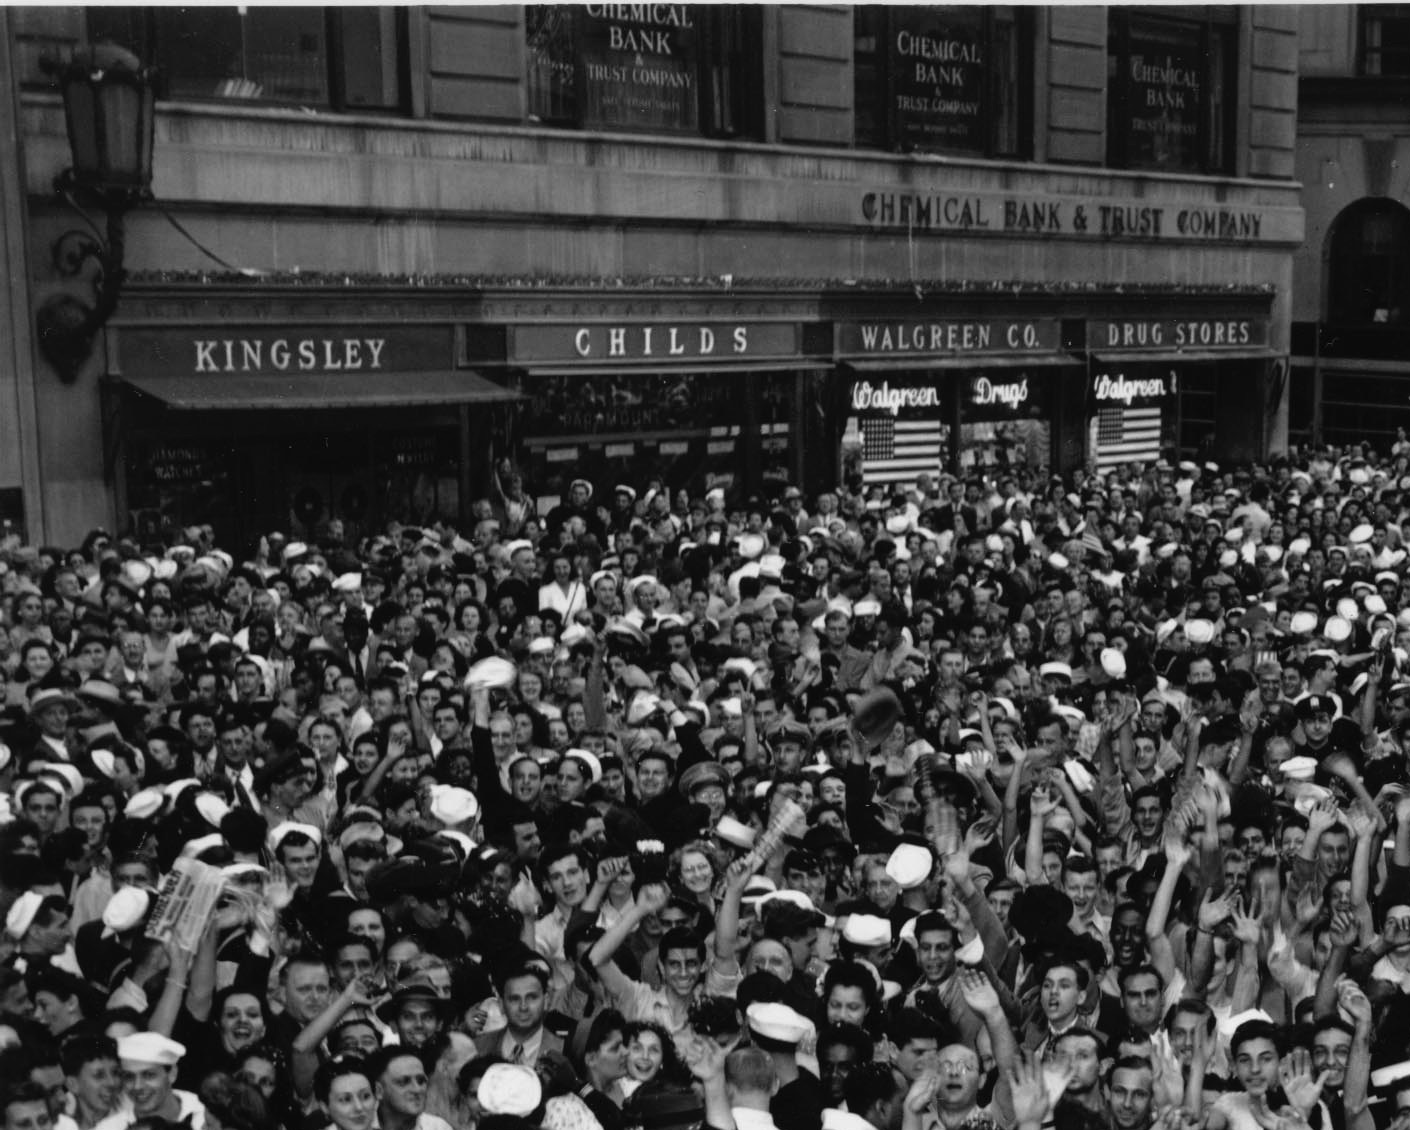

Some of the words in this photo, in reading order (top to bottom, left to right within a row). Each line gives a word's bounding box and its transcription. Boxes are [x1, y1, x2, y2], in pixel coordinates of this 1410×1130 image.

[586, 5, 693, 29] CHEMICAL
[609, 25, 672, 55] BANK
[897, 30, 981, 64] CHEMICAL
[588, 64, 627, 83] TRUST
[632, 68, 693, 89] COMPANY
[916, 63, 963, 87] BANK
[1132, 60, 1199, 88] CHEMICAL
[897, 95, 928, 112] TRUST
[932, 97, 978, 116] COMPANY
[1146, 88, 1185, 109] BANK
[862, 192, 989, 228] CHEMICAL
[1004, 200, 1061, 231] BANK
[1073, 204, 1088, 231] &
[1098, 205, 1164, 236] TRUST
[1177, 209, 1262, 238] COMPANY
[575, 326, 748, 357] CHILDS
[861, 324, 991, 350] WALGREEN
[1007, 323, 1040, 348] CO.
[1108, 322, 1162, 346] DRUG
[1176, 321, 1249, 345] STORES
[193, 338, 385, 372] KINGSLEY
[852, 380, 940, 416] Walgreen
[972, 377, 1028, 409] Drugs
[1094, 374, 1167, 405] Walgreen
